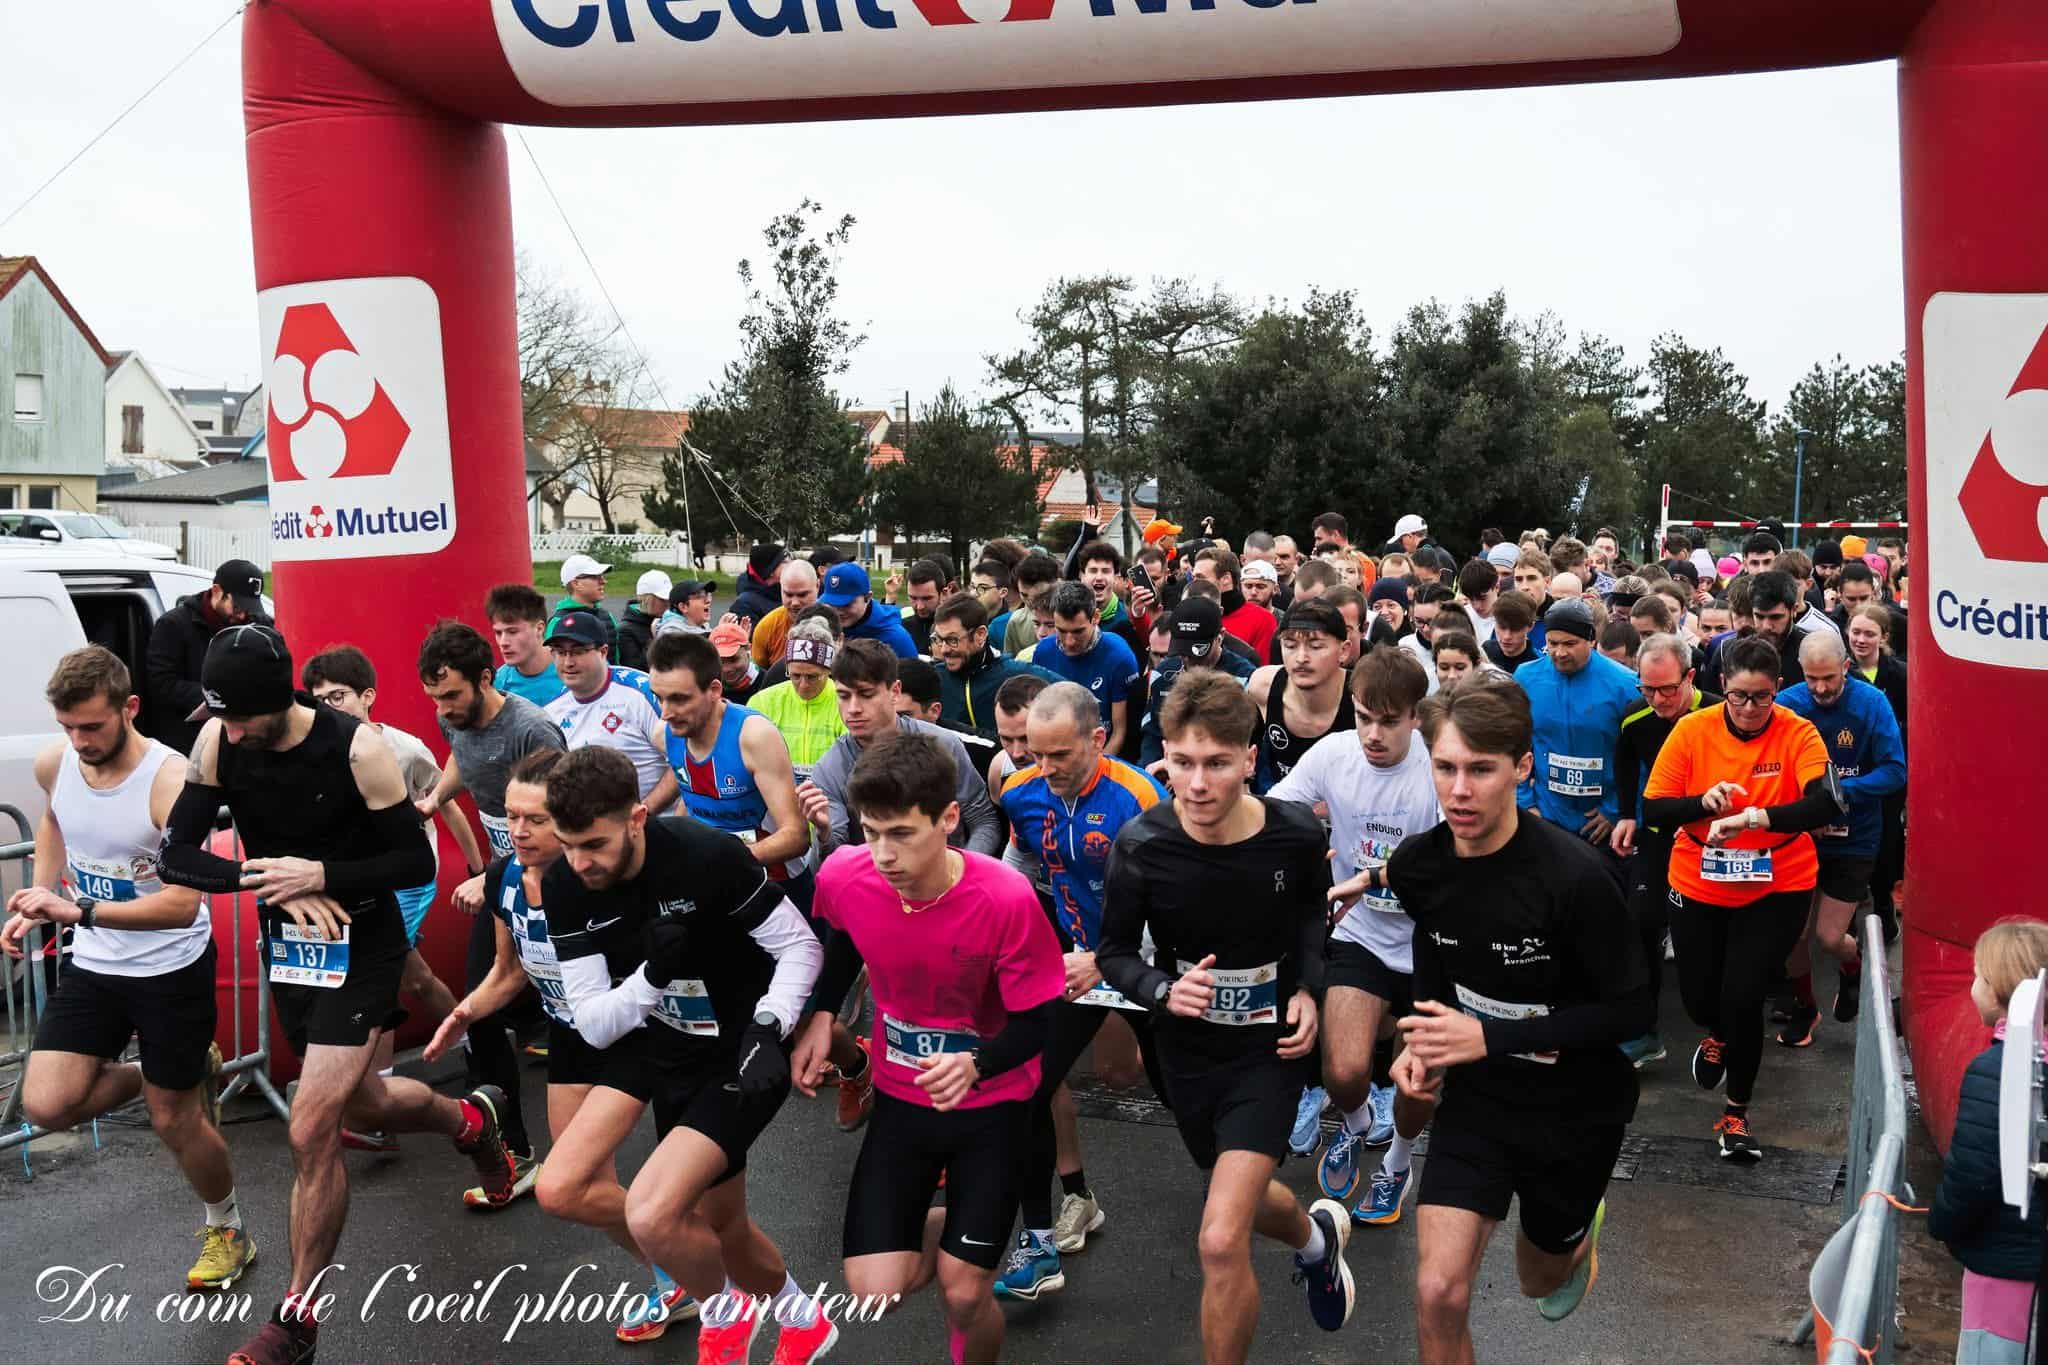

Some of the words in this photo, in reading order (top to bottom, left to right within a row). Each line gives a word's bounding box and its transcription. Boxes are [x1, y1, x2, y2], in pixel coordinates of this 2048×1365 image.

[336, 503, 448, 537] Mutuel
[1937, 590, 2048, 641] Crédit
[1567, 769, 1583, 785] 69
[1366, 823, 1403, 837] ENDURO
[1724, 861, 1753, 873] 169
[83, 875, 114, 900] 149
[295, 943, 327, 968] 137
[1492, 943, 1502, 951] 10
[1503, 944, 1518, 952] km
[1504, 955, 1551, 966] Avranches
[916, 1033, 947, 1056] 87
